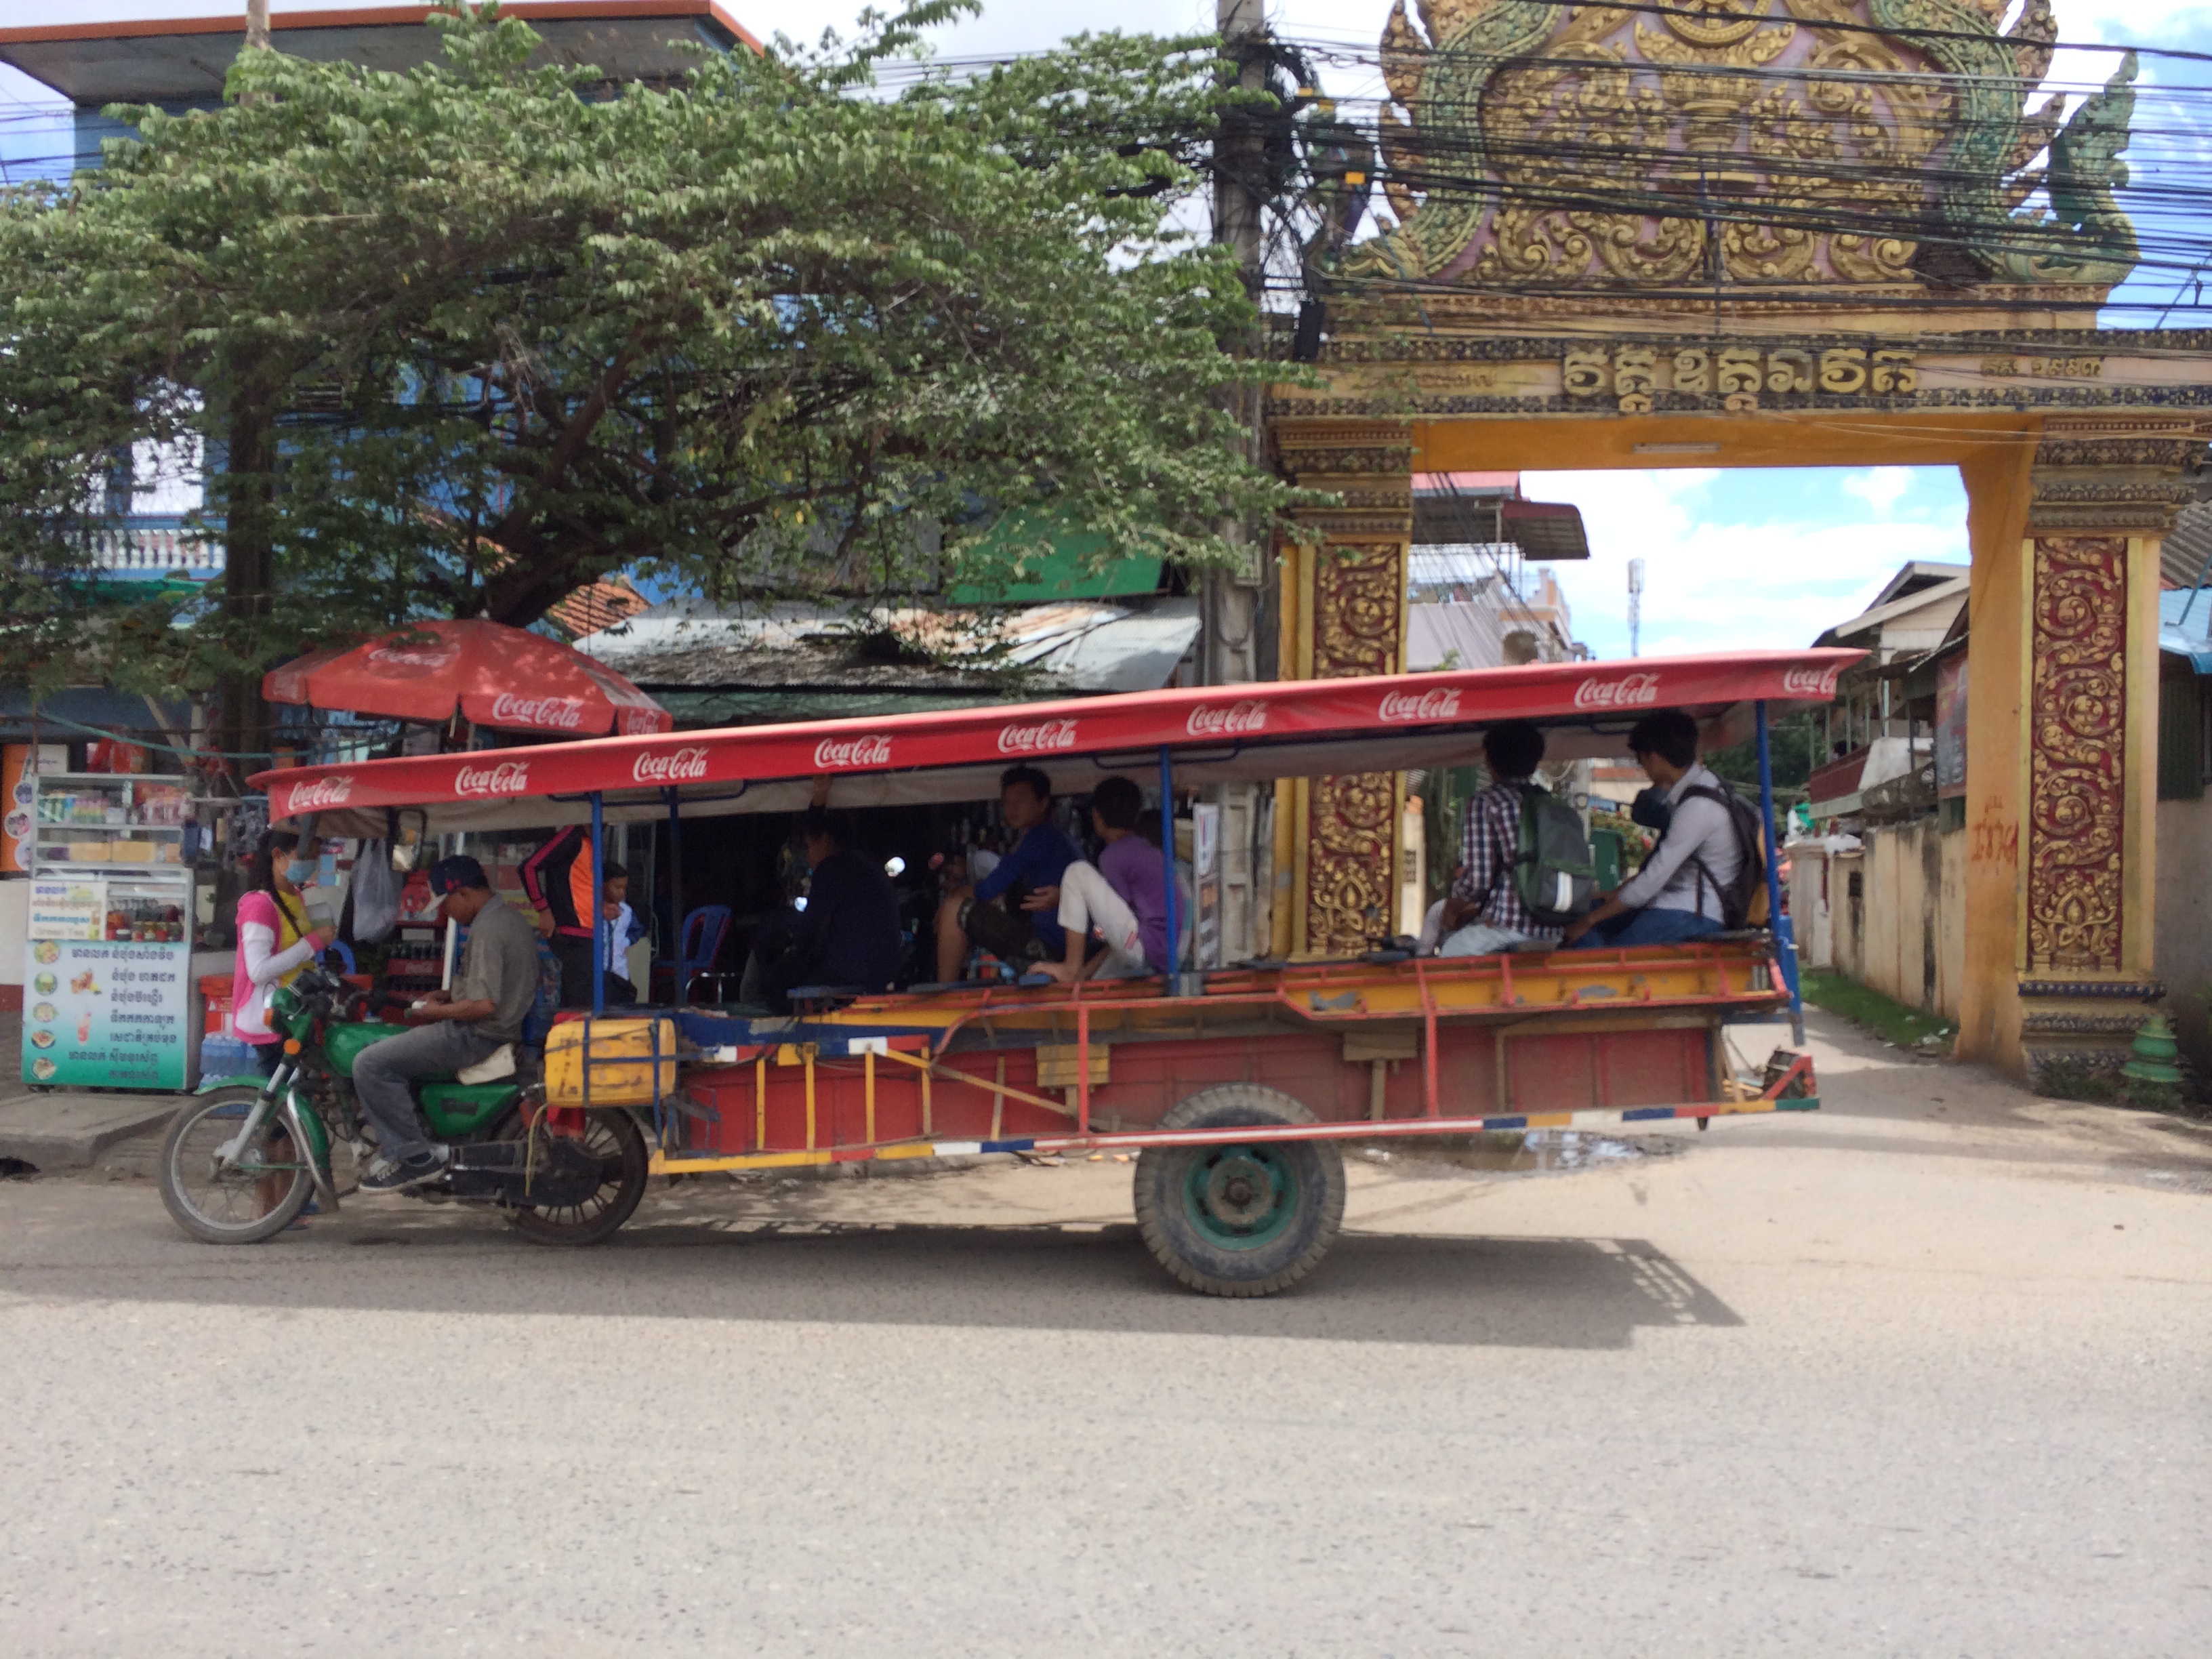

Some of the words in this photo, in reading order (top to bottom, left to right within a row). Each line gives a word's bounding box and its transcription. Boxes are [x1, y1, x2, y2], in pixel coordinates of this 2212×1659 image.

[1378, 687, 1463, 722] Coca-Cola
[1574, 672, 1661, 708] Coca-Cola
[492, 693, 583, 729] Coca-Cola
[1186, 700, 1269, 737] Coca-Cola
[814, 735, 893, 768] Coca-Cola
[998, 719, 1079, 753] Coca-Cola
[455, 762, 530, 797] Coca-Cola
[633, 747, 710, 782] Coca-Cola
[288, 776, 355, 811] Coca-Cola
